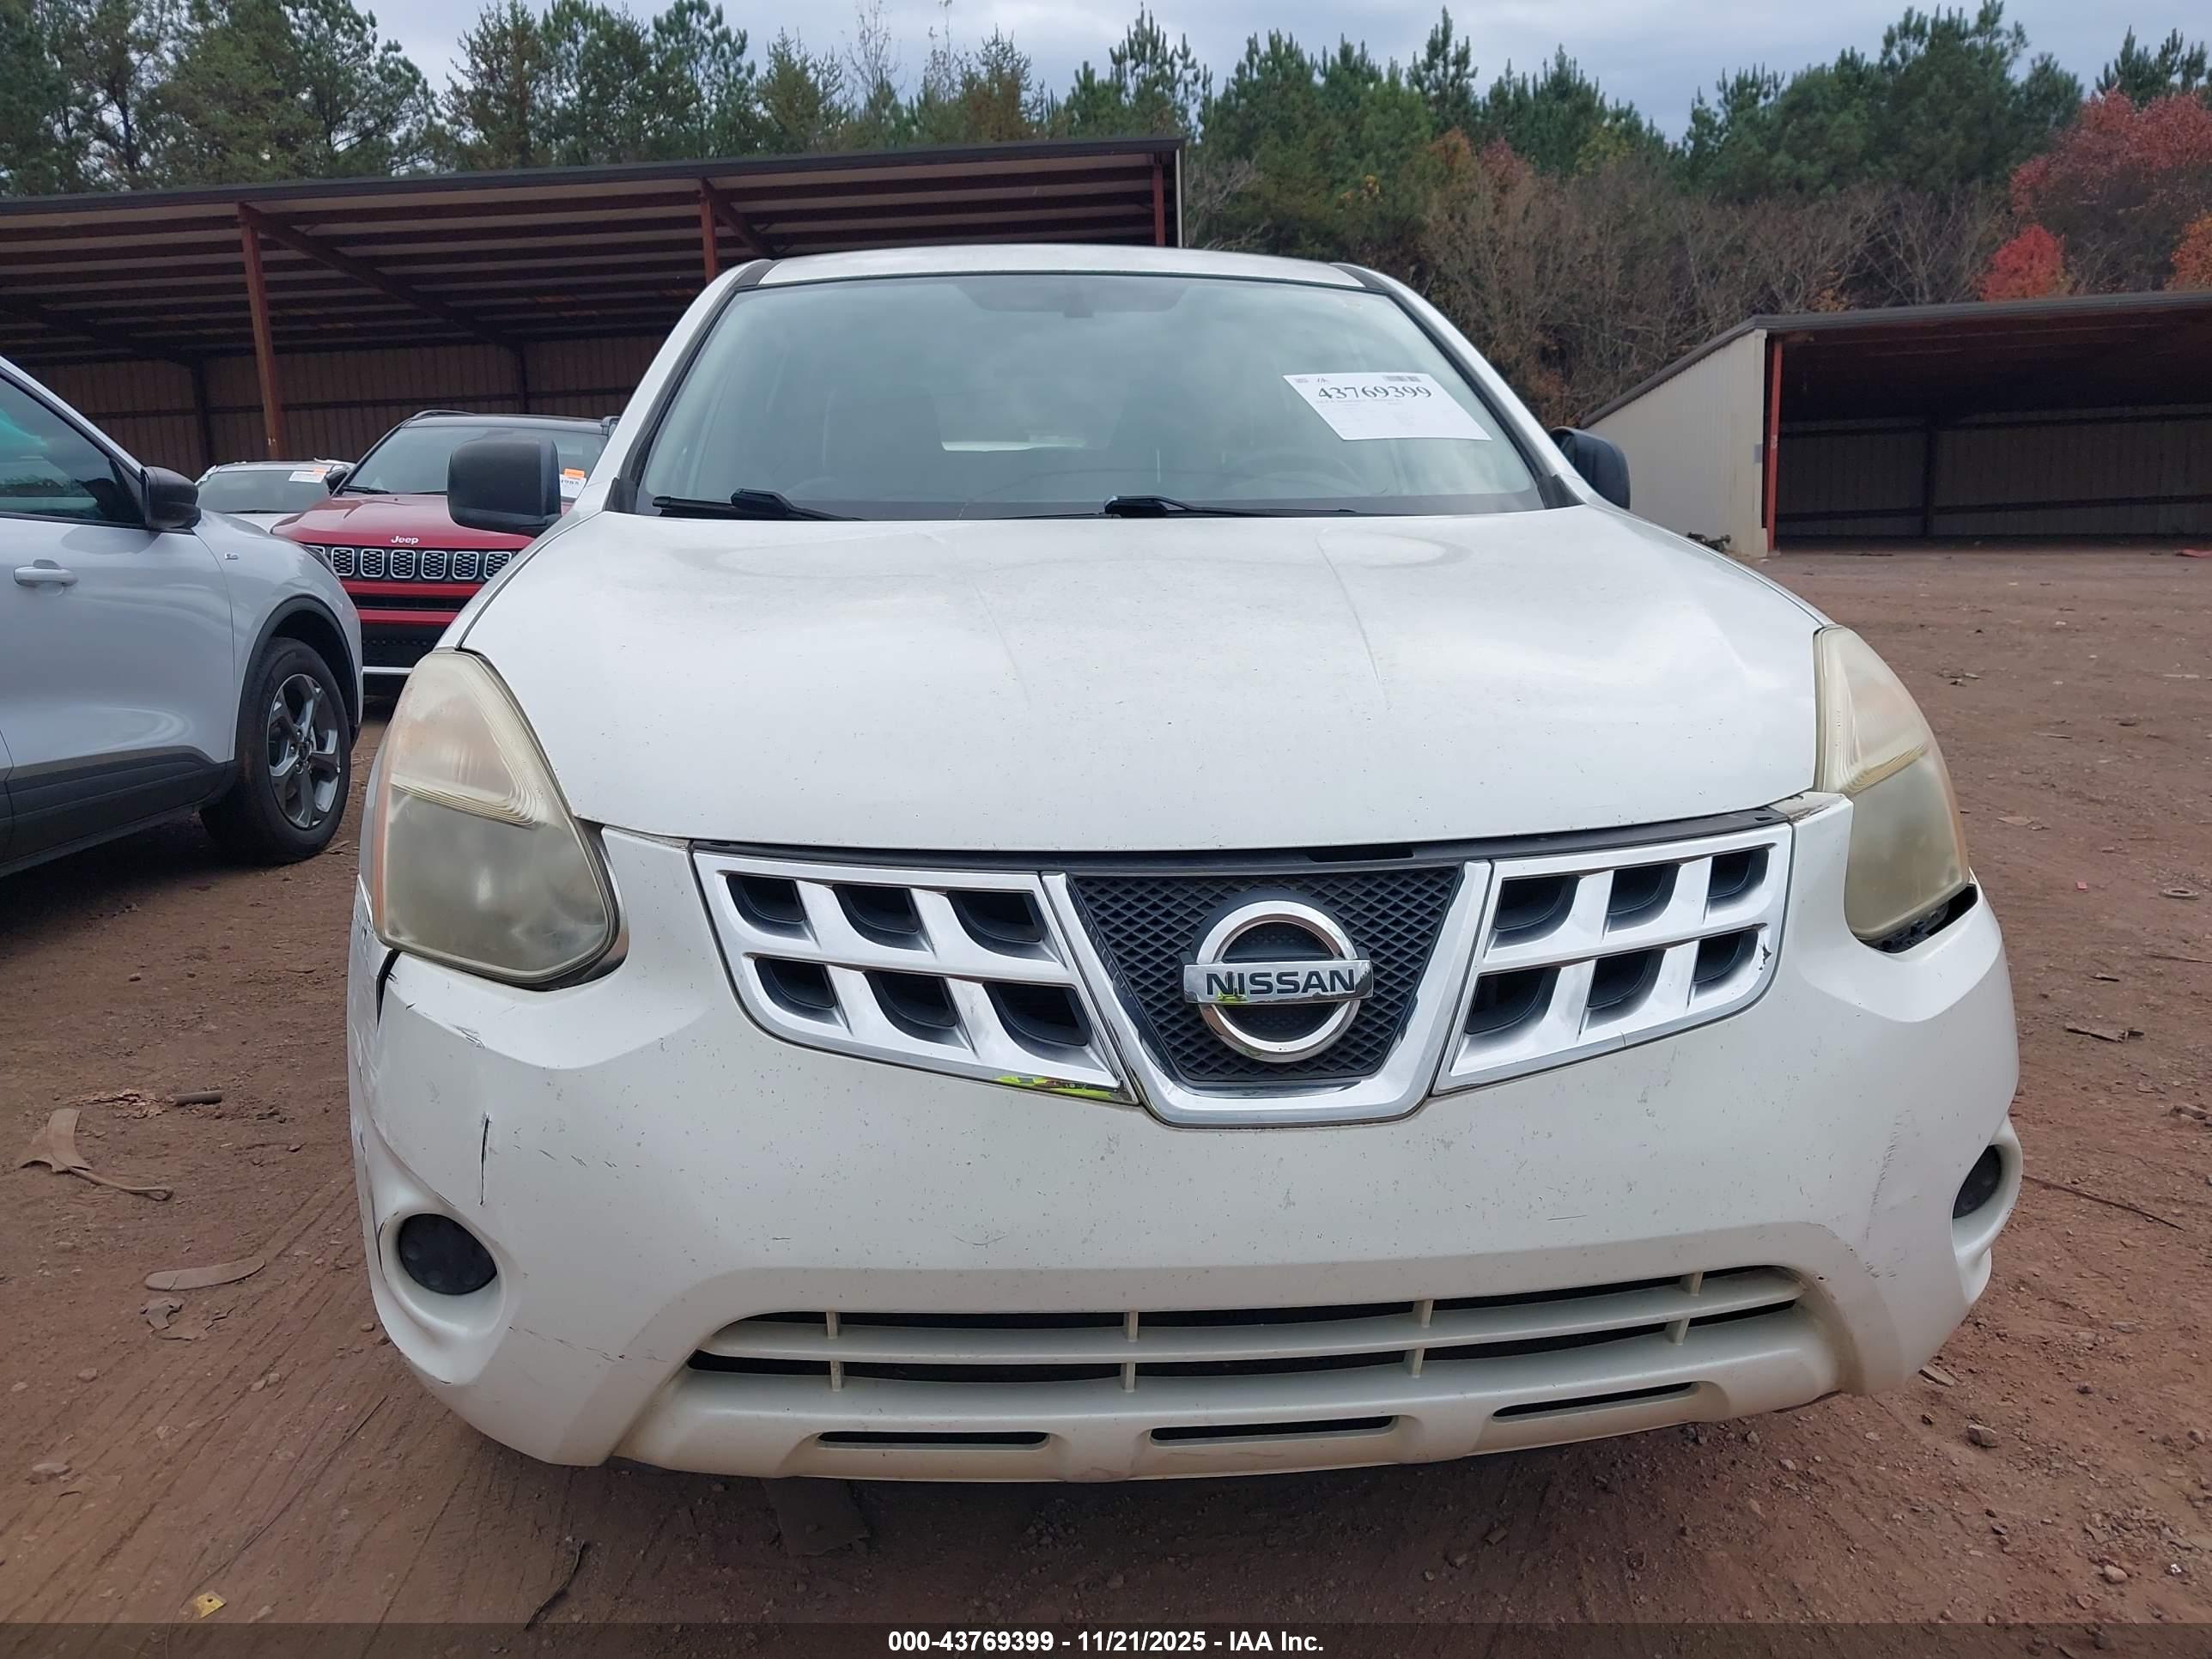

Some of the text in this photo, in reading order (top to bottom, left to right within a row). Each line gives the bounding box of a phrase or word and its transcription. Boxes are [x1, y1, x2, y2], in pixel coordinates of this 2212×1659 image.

[1318, 386, 1432, 399] 43769399
[391, 535, 419, 545] Jeep
[1206, 969, 1356, 995] NISSAN
